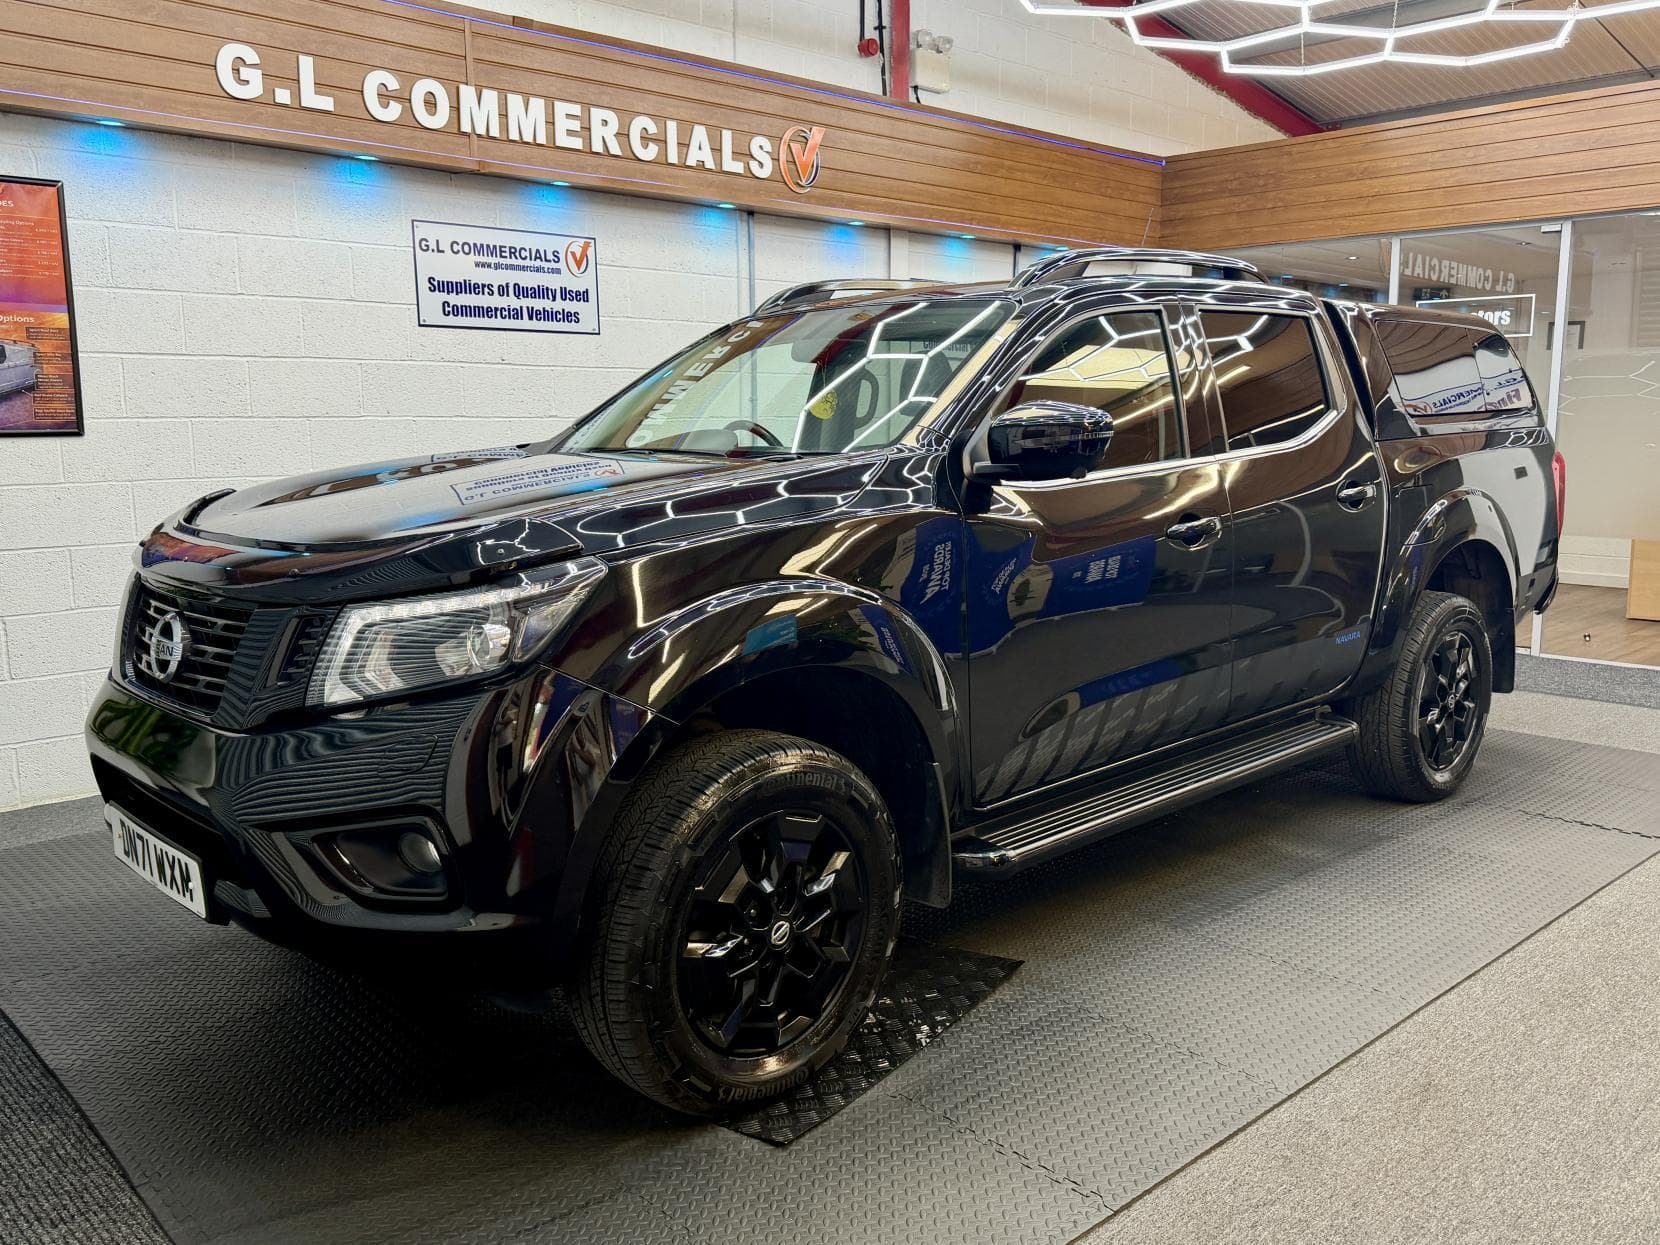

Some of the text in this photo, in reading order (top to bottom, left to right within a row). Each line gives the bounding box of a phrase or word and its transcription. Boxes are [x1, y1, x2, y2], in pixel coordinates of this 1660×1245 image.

[215, 43, 774, 180] G.L COMMERCIALS
[418, 237, 561, 264] G.L COMMERCIALS
[474, 260, 562, 275] www.glcommercials.com
[428, 276, 590, 303] Suppliers of Quality Used
[442, 300, 581, 324] Commercial Vehicles
